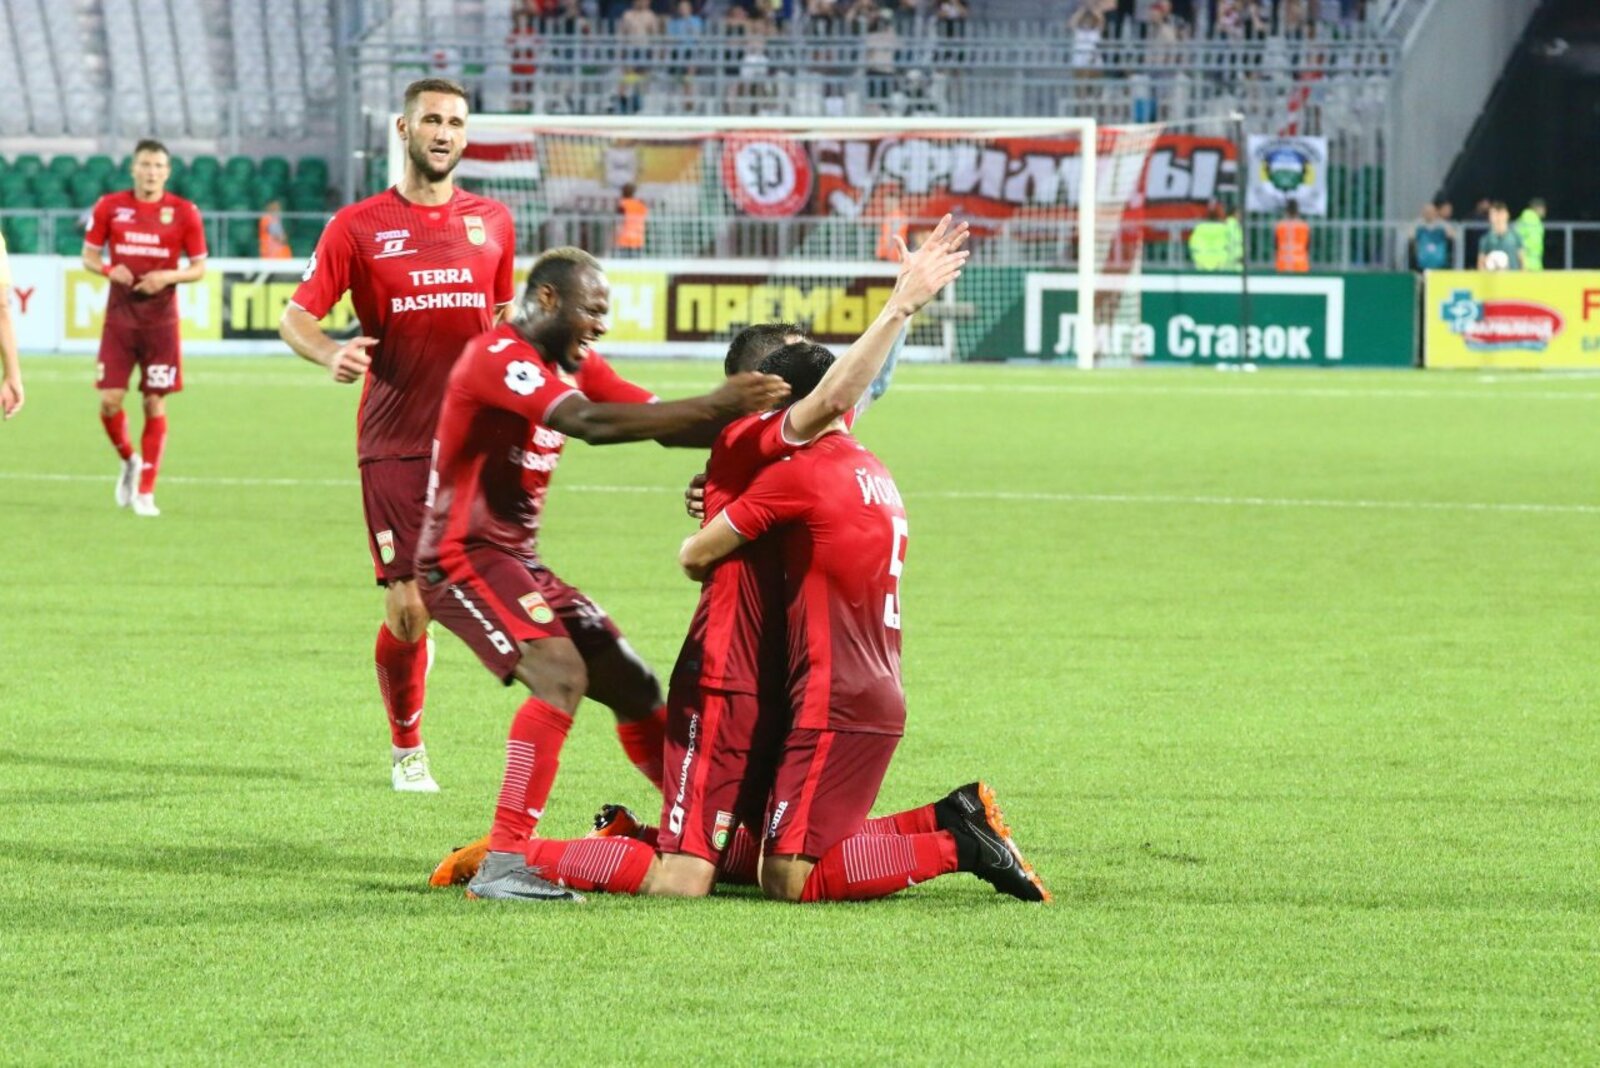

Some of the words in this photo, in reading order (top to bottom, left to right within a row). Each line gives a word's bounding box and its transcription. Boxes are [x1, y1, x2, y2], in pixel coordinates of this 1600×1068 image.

[408, 268, 473, 286] TERRA
[391, 292, 486, 313] BASHKIRIA
[1167, 314, 1312, 359] Ставок
